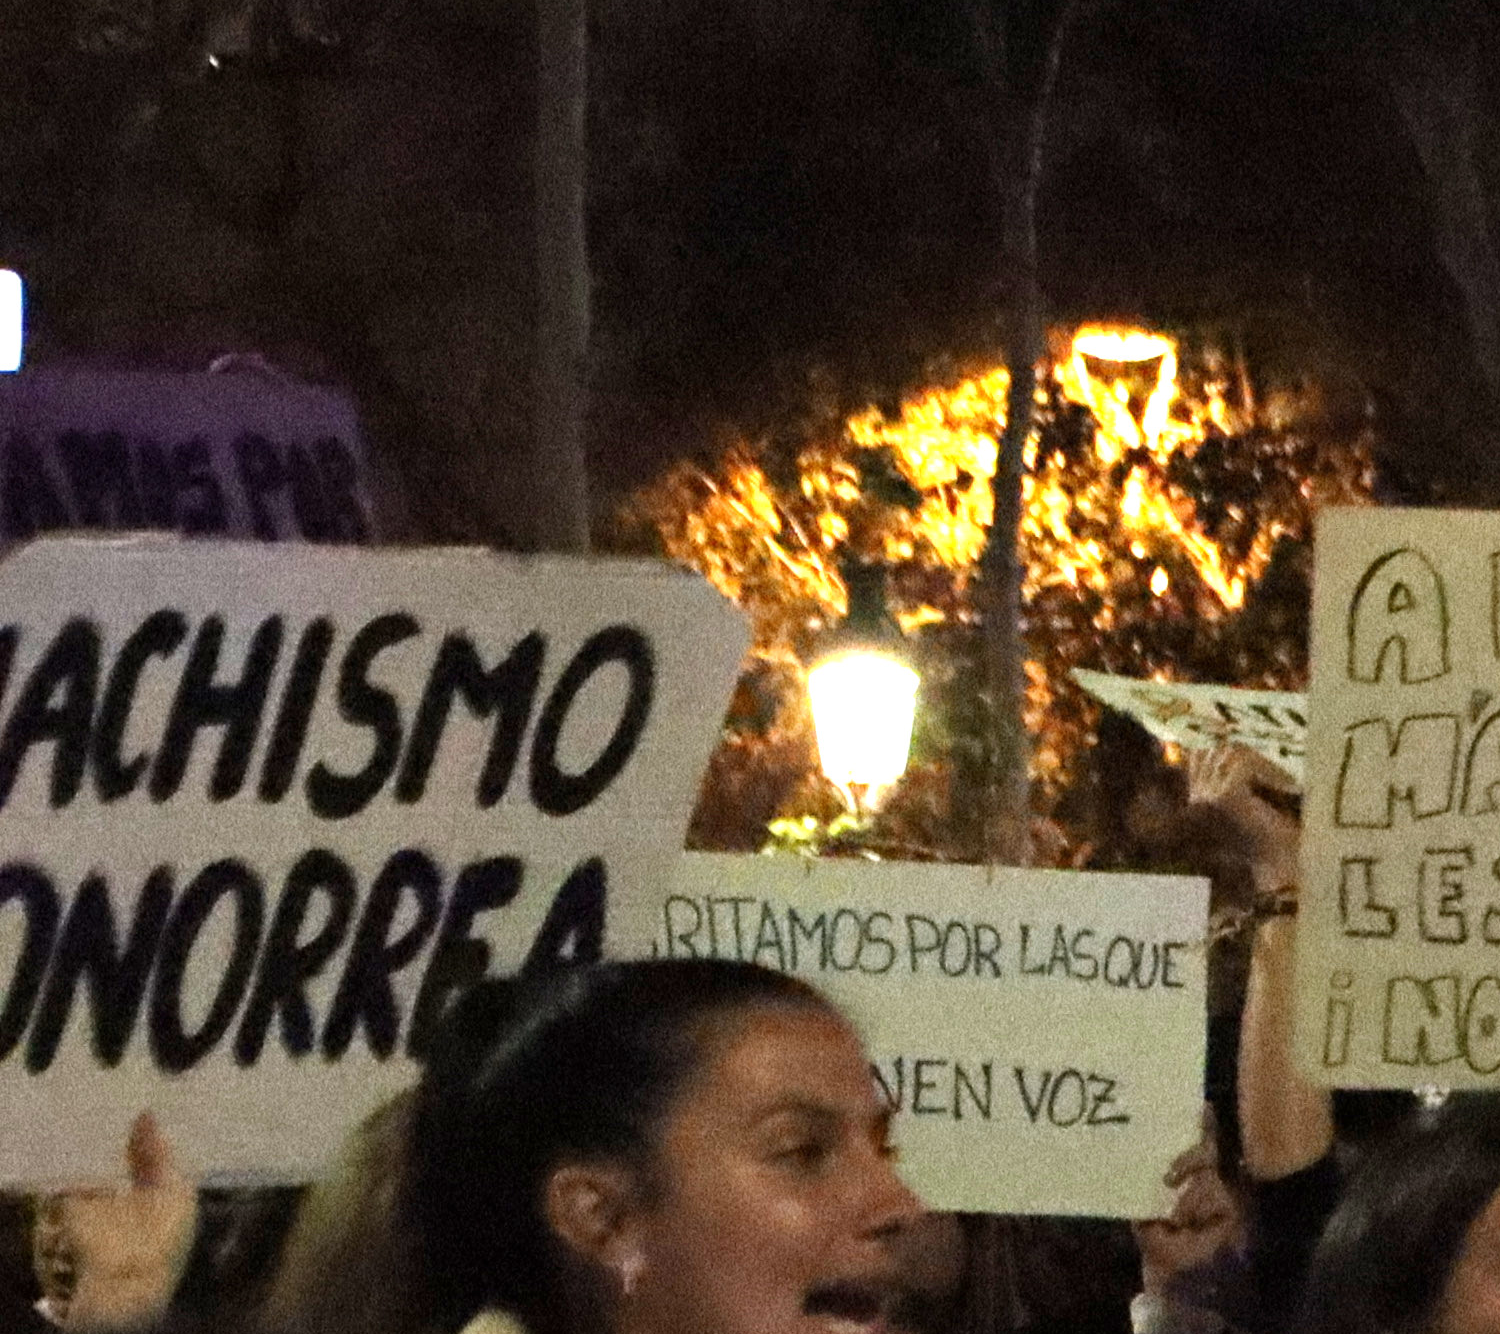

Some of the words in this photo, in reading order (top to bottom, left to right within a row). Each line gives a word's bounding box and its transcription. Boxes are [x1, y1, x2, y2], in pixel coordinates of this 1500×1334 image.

[1347, 545, 1452, 685] A
[0, 608, 656, 820] ACHISMO
[652, 894, 896, 976] RITAMOS
[904, 913, 1001, 979] POR
[1013, 1066, 1131, 1127] VOZ
